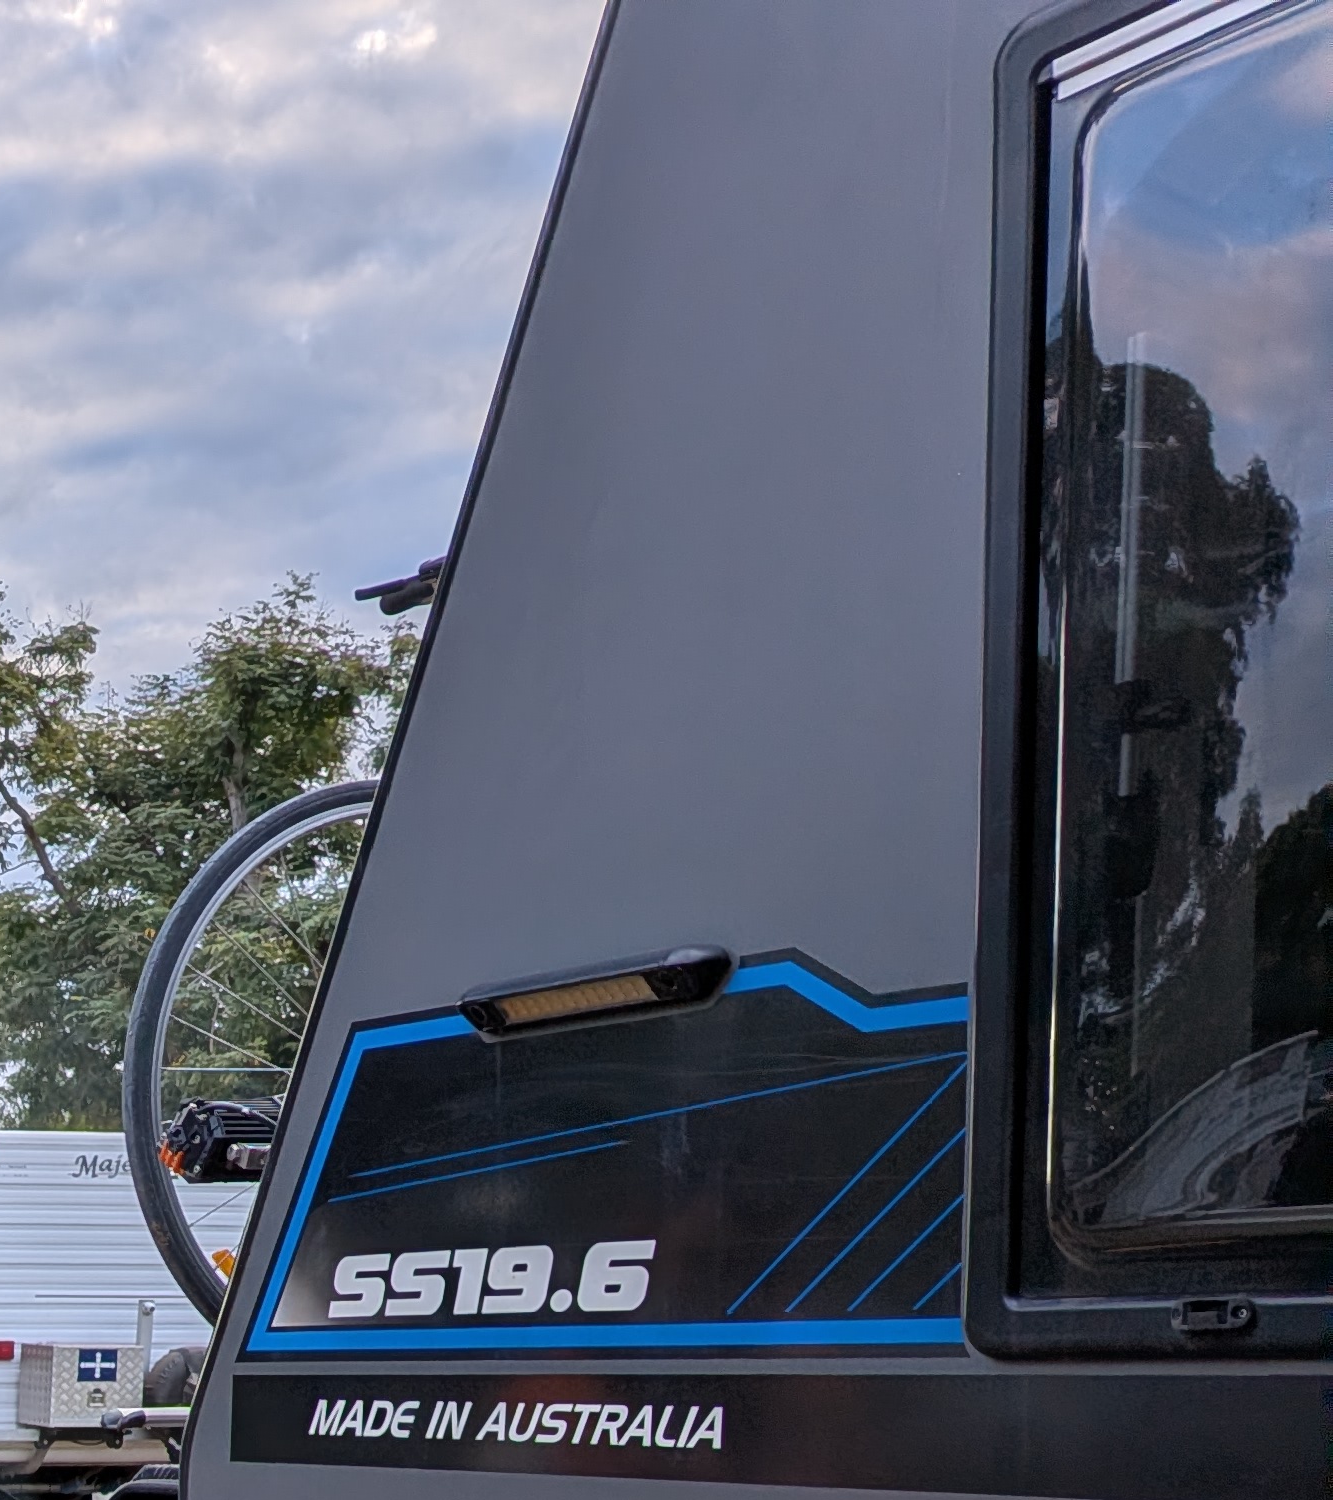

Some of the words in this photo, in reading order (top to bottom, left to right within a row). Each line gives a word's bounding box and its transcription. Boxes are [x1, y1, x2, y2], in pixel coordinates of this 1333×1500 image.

[67, 1154, 133, 1179] Maje
[328, 1239, 657, 1319] SS19.6
[308, 1399, 420, 1439] MADE
[425, 1400, 473, 1440] IN
[475, 1402, 724, 1449] AUSTRALIA
